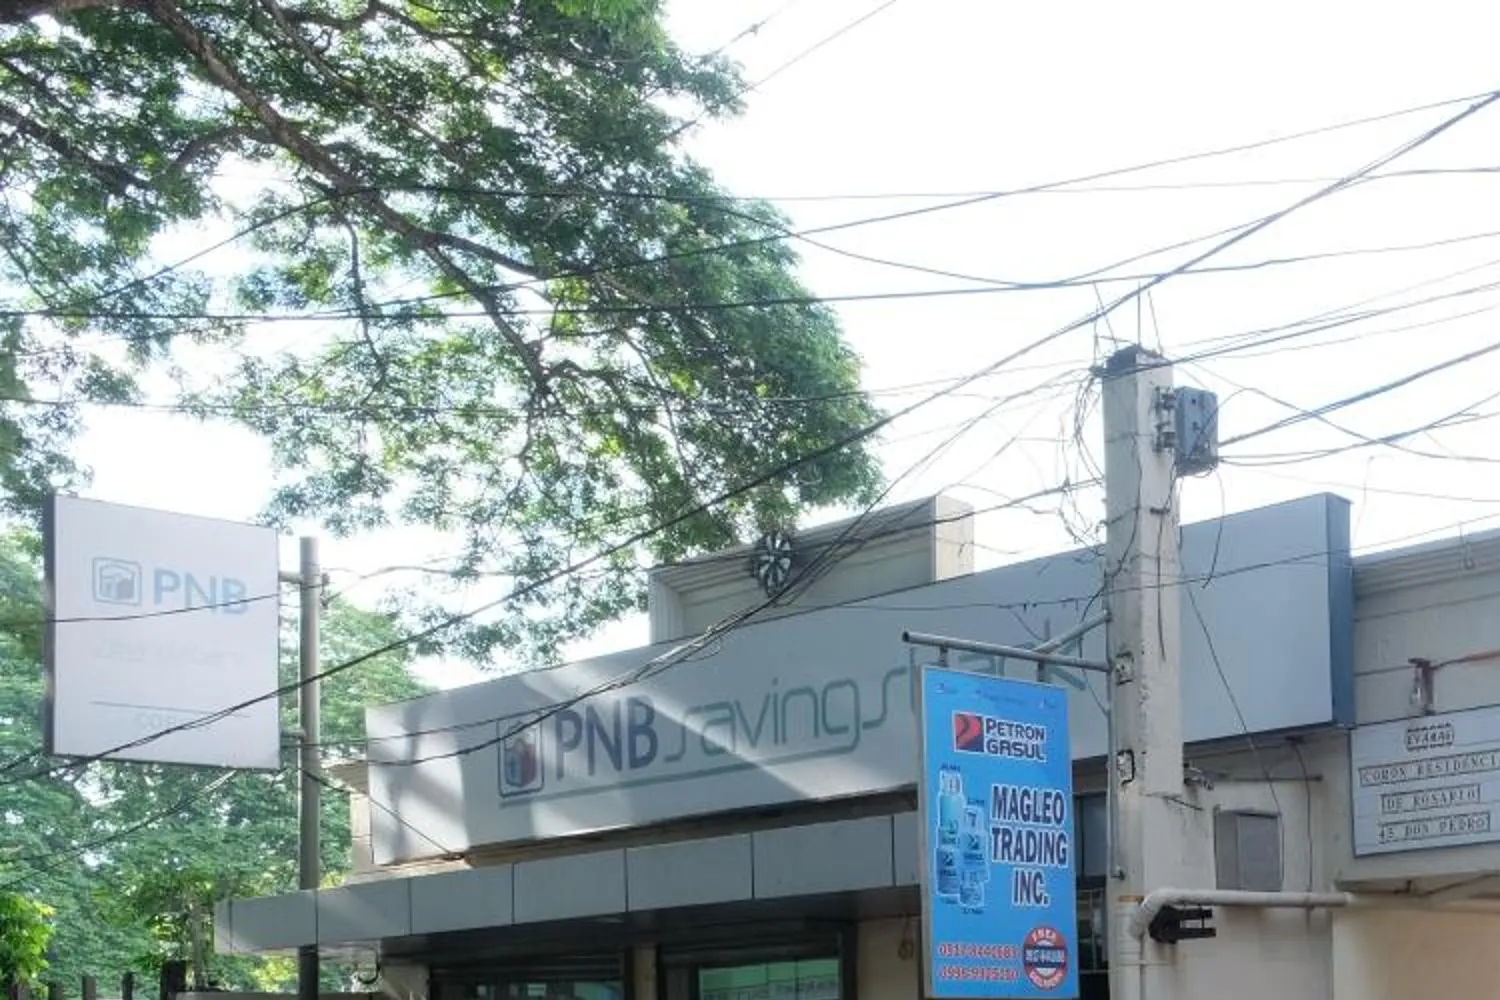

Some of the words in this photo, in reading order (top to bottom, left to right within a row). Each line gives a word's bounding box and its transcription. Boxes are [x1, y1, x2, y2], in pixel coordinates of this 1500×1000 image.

[153, 568, 249, 615] PNB
[555, 695, 658, 780] PNB
[984, 716, 1046, 742] PETRON
[1362, 767, 1407, 783] CORON
[992, 785, 1065, 823] MAGLEO
[1386, 796, 1403, 811] DE
[1439, 817, 1486, 834] PEDRO
[992, 827, 1067, 865] TRADING
[1013, 868, 1049, 906] INC.
